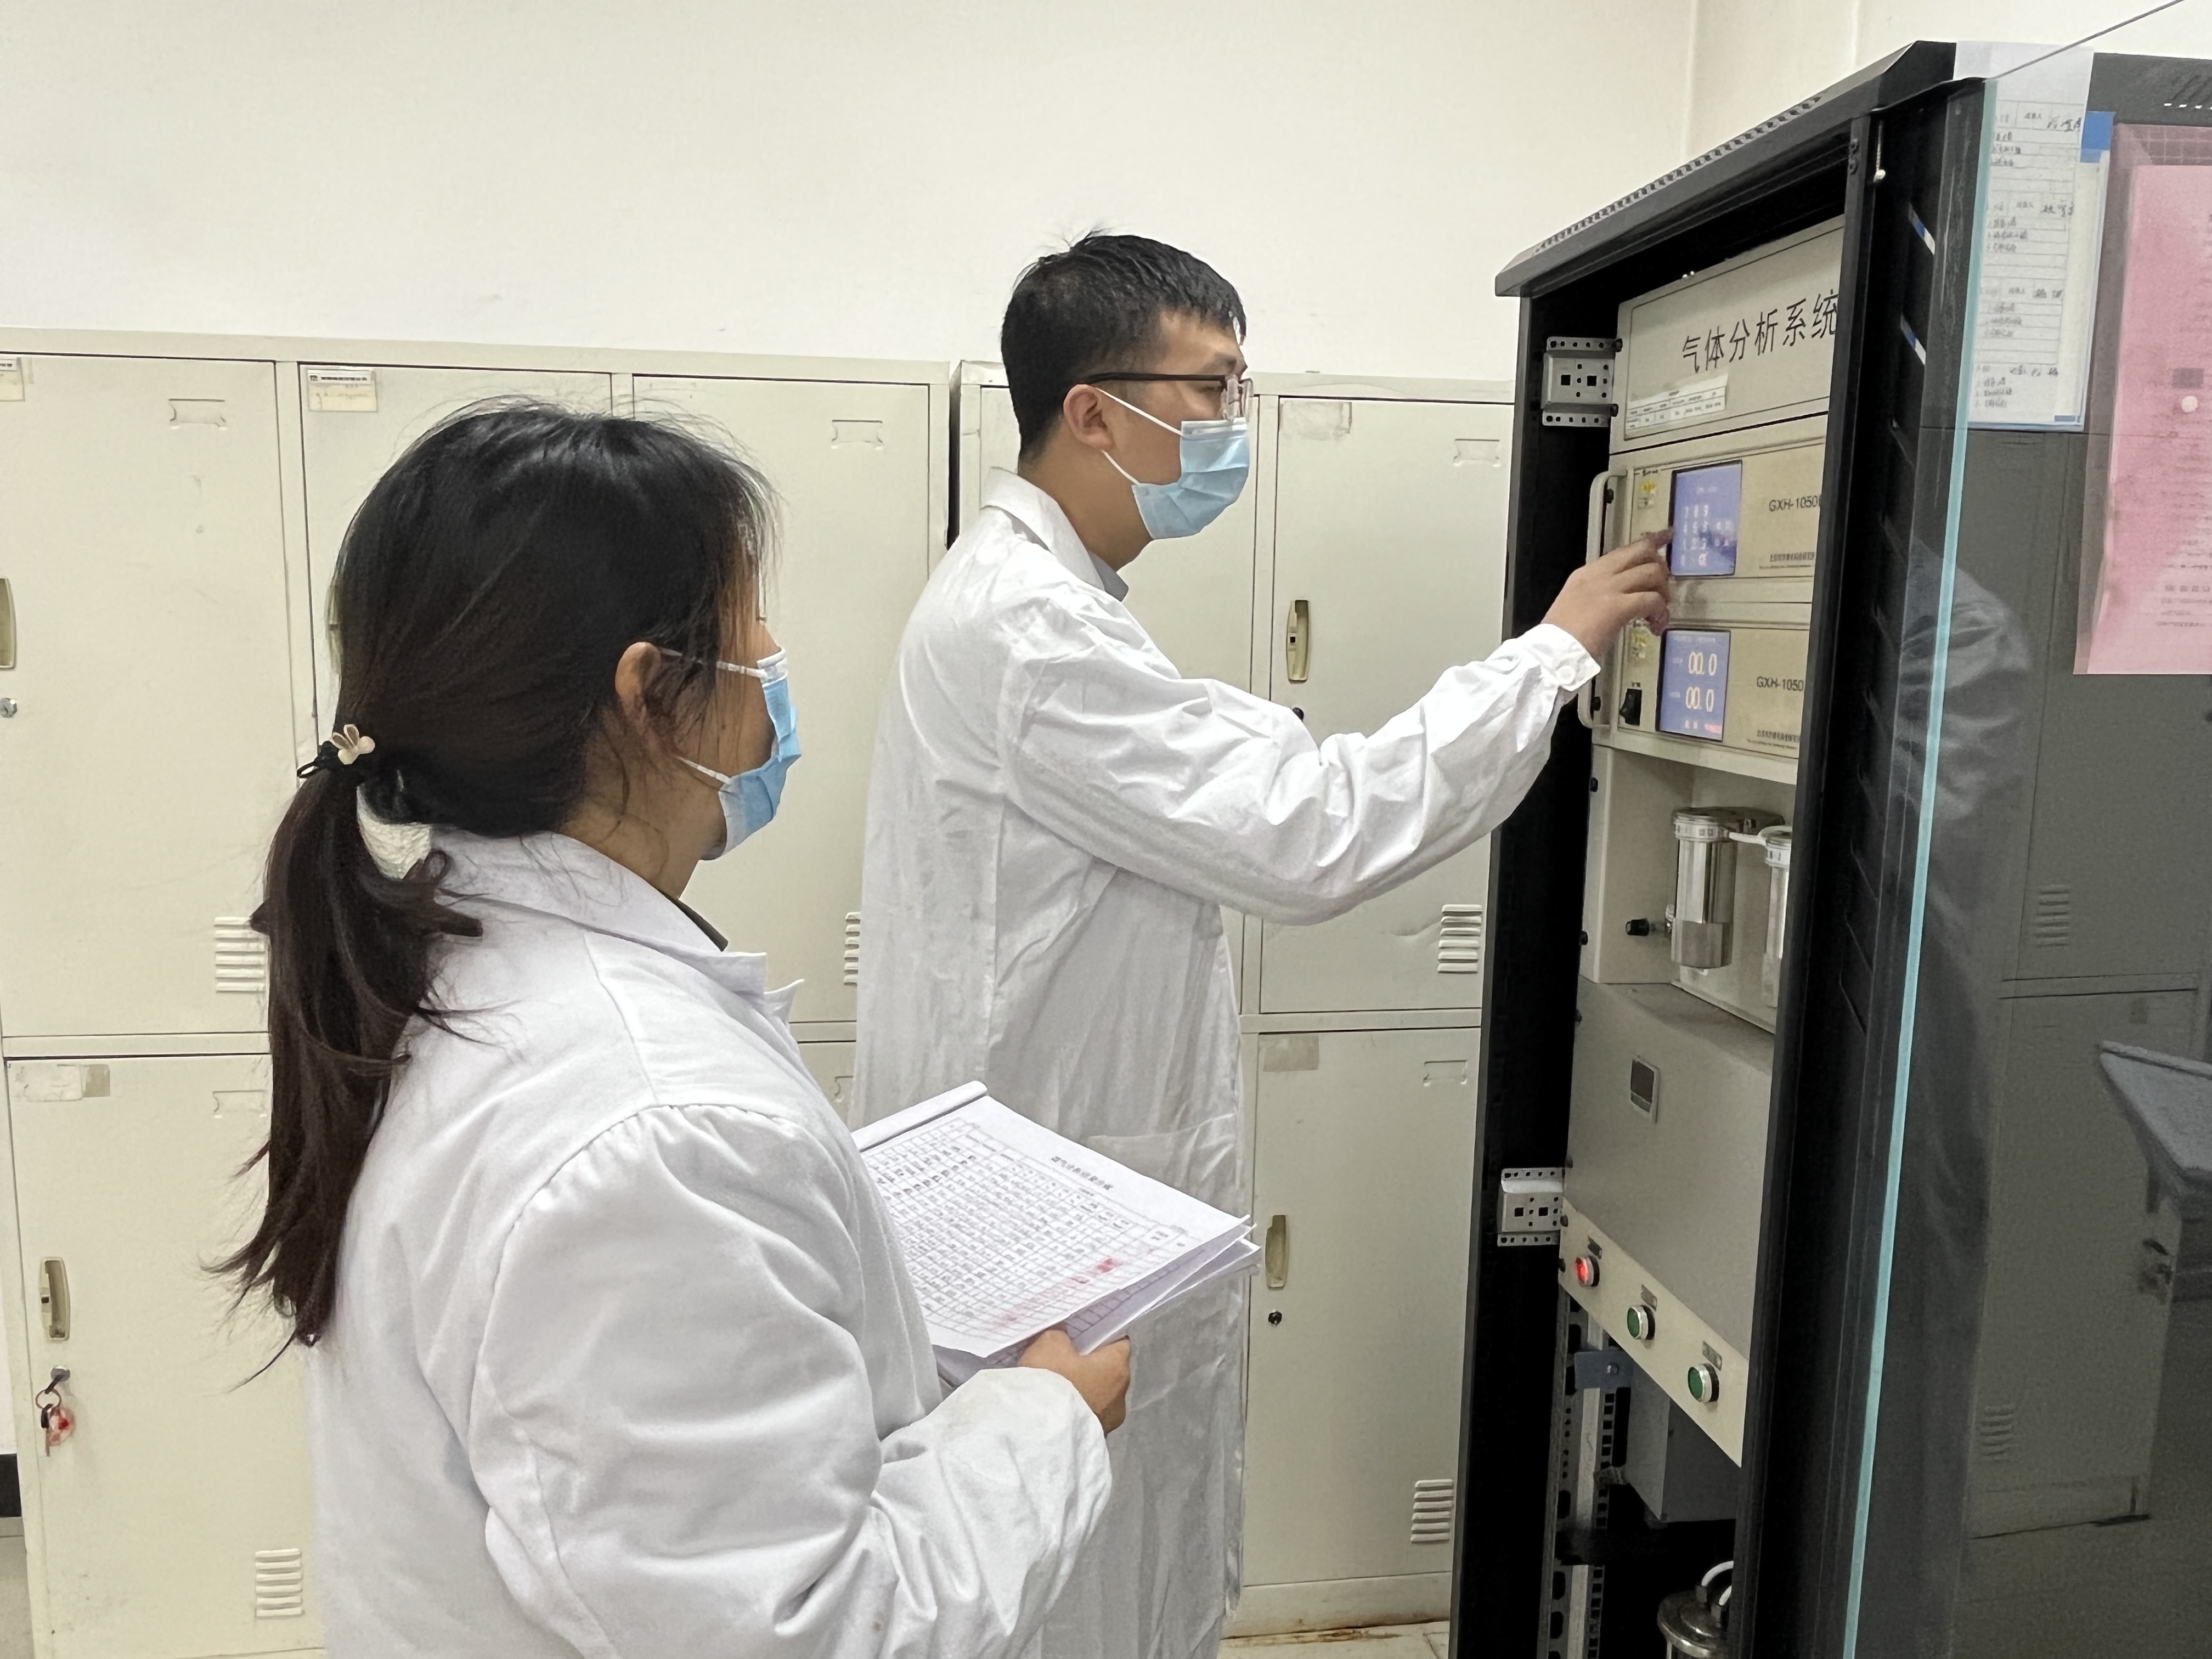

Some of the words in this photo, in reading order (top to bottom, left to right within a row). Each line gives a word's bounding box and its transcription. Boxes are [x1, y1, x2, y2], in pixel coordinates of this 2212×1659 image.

[1683, 289, 1838, 374] 气体分析系统
[1757, 676, 1804, 691] GXH-1050
